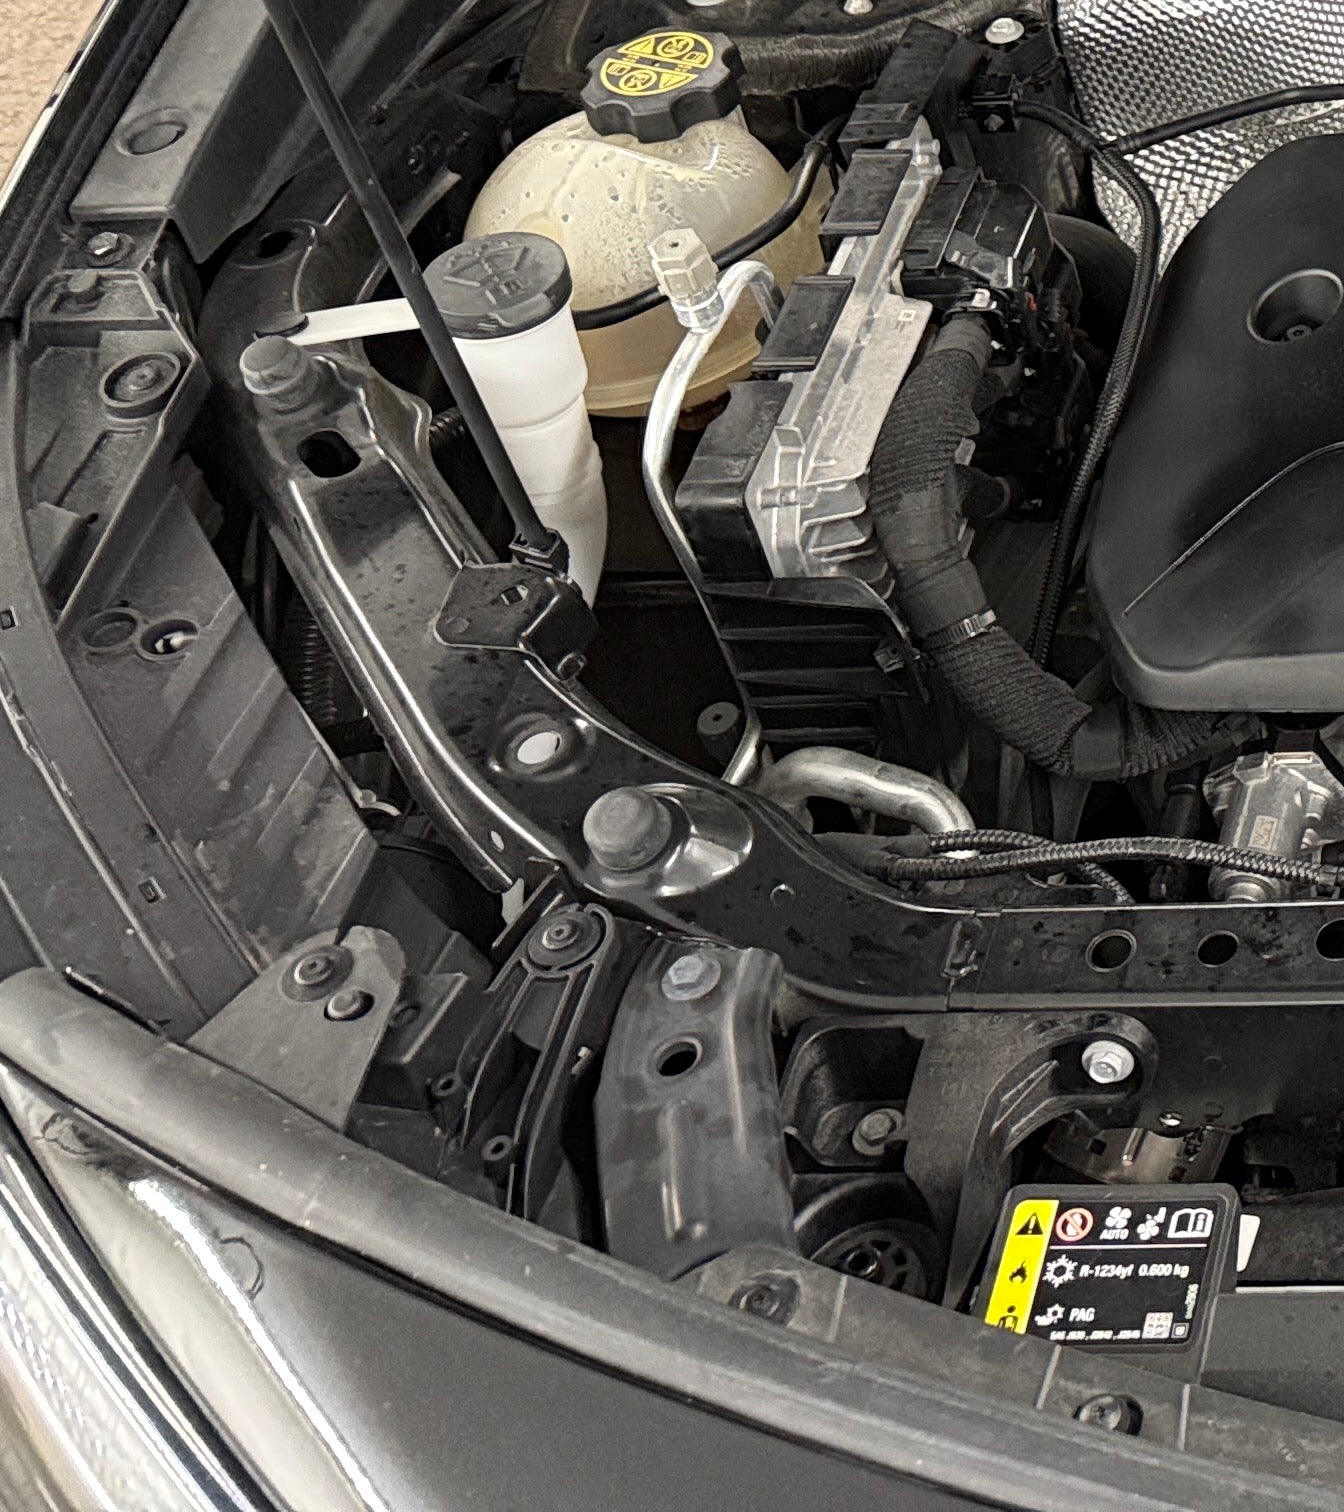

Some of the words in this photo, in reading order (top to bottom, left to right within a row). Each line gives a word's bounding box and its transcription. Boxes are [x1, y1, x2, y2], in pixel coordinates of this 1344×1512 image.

[1099, 1228, 1129, 1240] AUTO
[1079, 1263, 1135, 1279] R-1234yf
[1138, 1263, 1173, 1277] 0.600
[1173, 1263, 1190, 1278] kg
[1068, 1308, 1096, 1322] PAG
